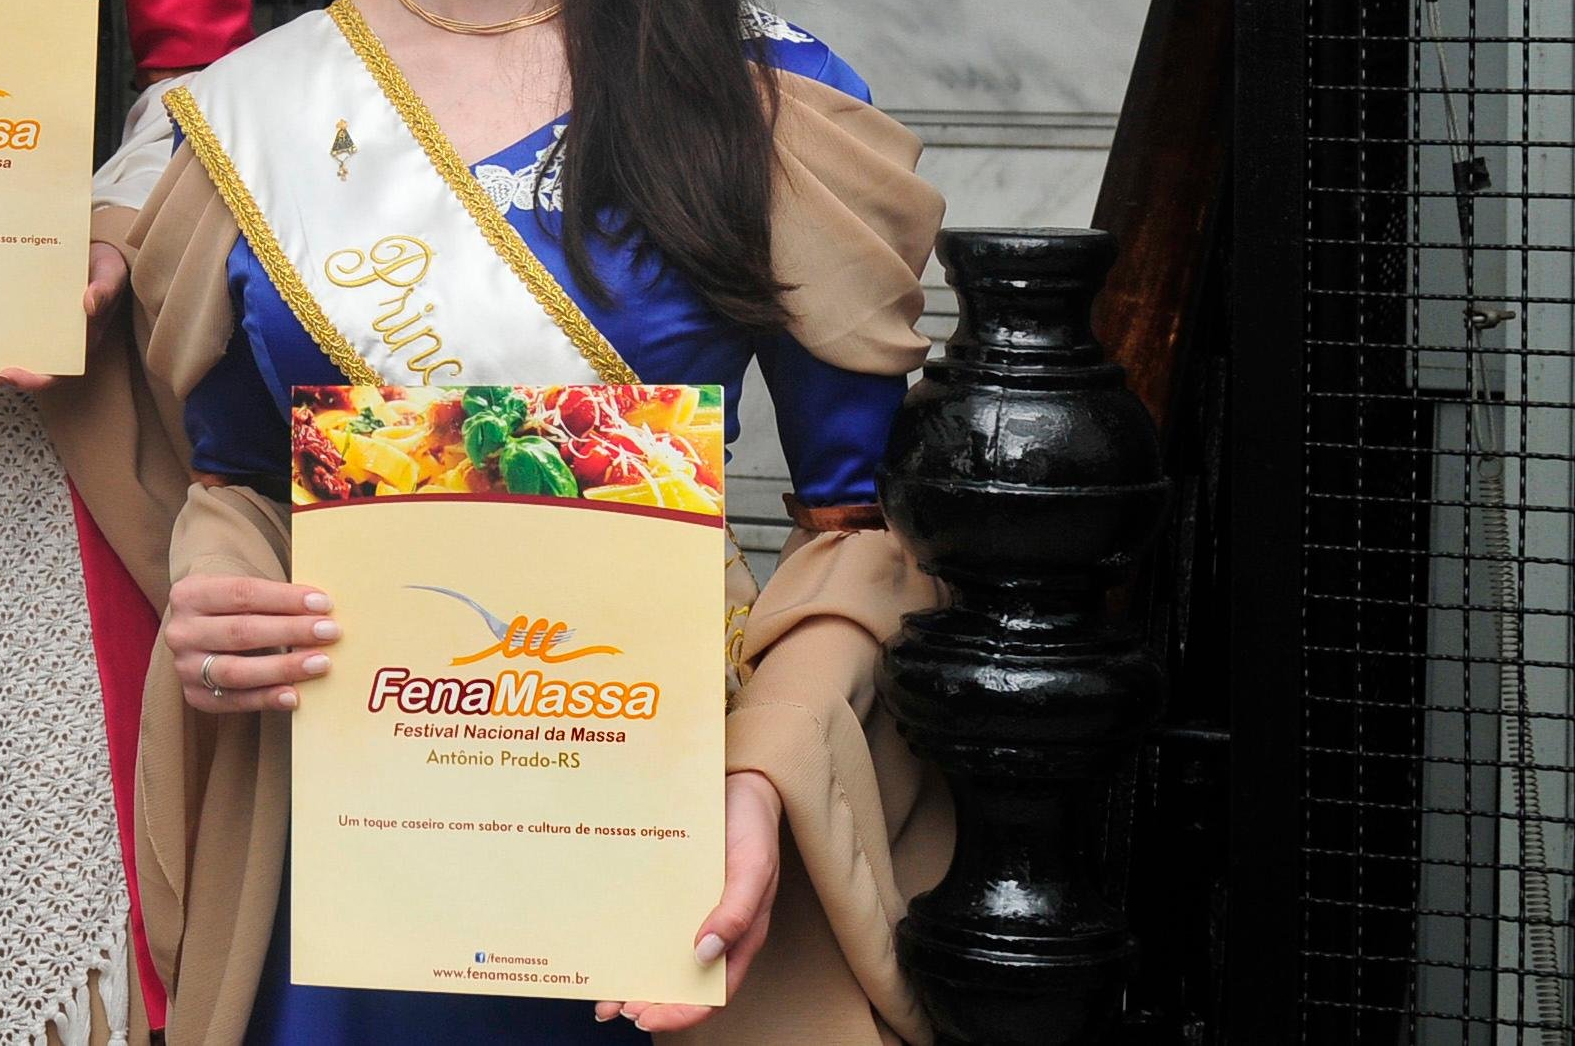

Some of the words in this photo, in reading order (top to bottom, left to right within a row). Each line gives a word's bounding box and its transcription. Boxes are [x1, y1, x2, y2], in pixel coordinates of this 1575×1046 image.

[21, 235, 62, 246] origens.
[368, 667, 660, 720] FenaMassa
[394, 723, 459, 739] Festival
[464, 725, 539, 741] Nacional
[544, 726, 565, 742] da
[570, 727, 626, 743] Massa
[426, 749, 494, 766] Antônio
[501, 751, 580, 769] Prado-RS
[338, 815, 359, 827] Um
[363, 816, 397, 831] toque
[401, 817, 445, 830] caseiro
[448, 821, 474, 831] com
[478, 819, 512, 832] sabor
[516, 824, 524, 833] e
[528, 821, 571, 834] cultura
[575, 823, 590, 835] de
[594, 826, 636, 837] nossas
[640, 827, 690, 840] origens.
[433, 966, 590, 985] www.fenamassa.com.br
